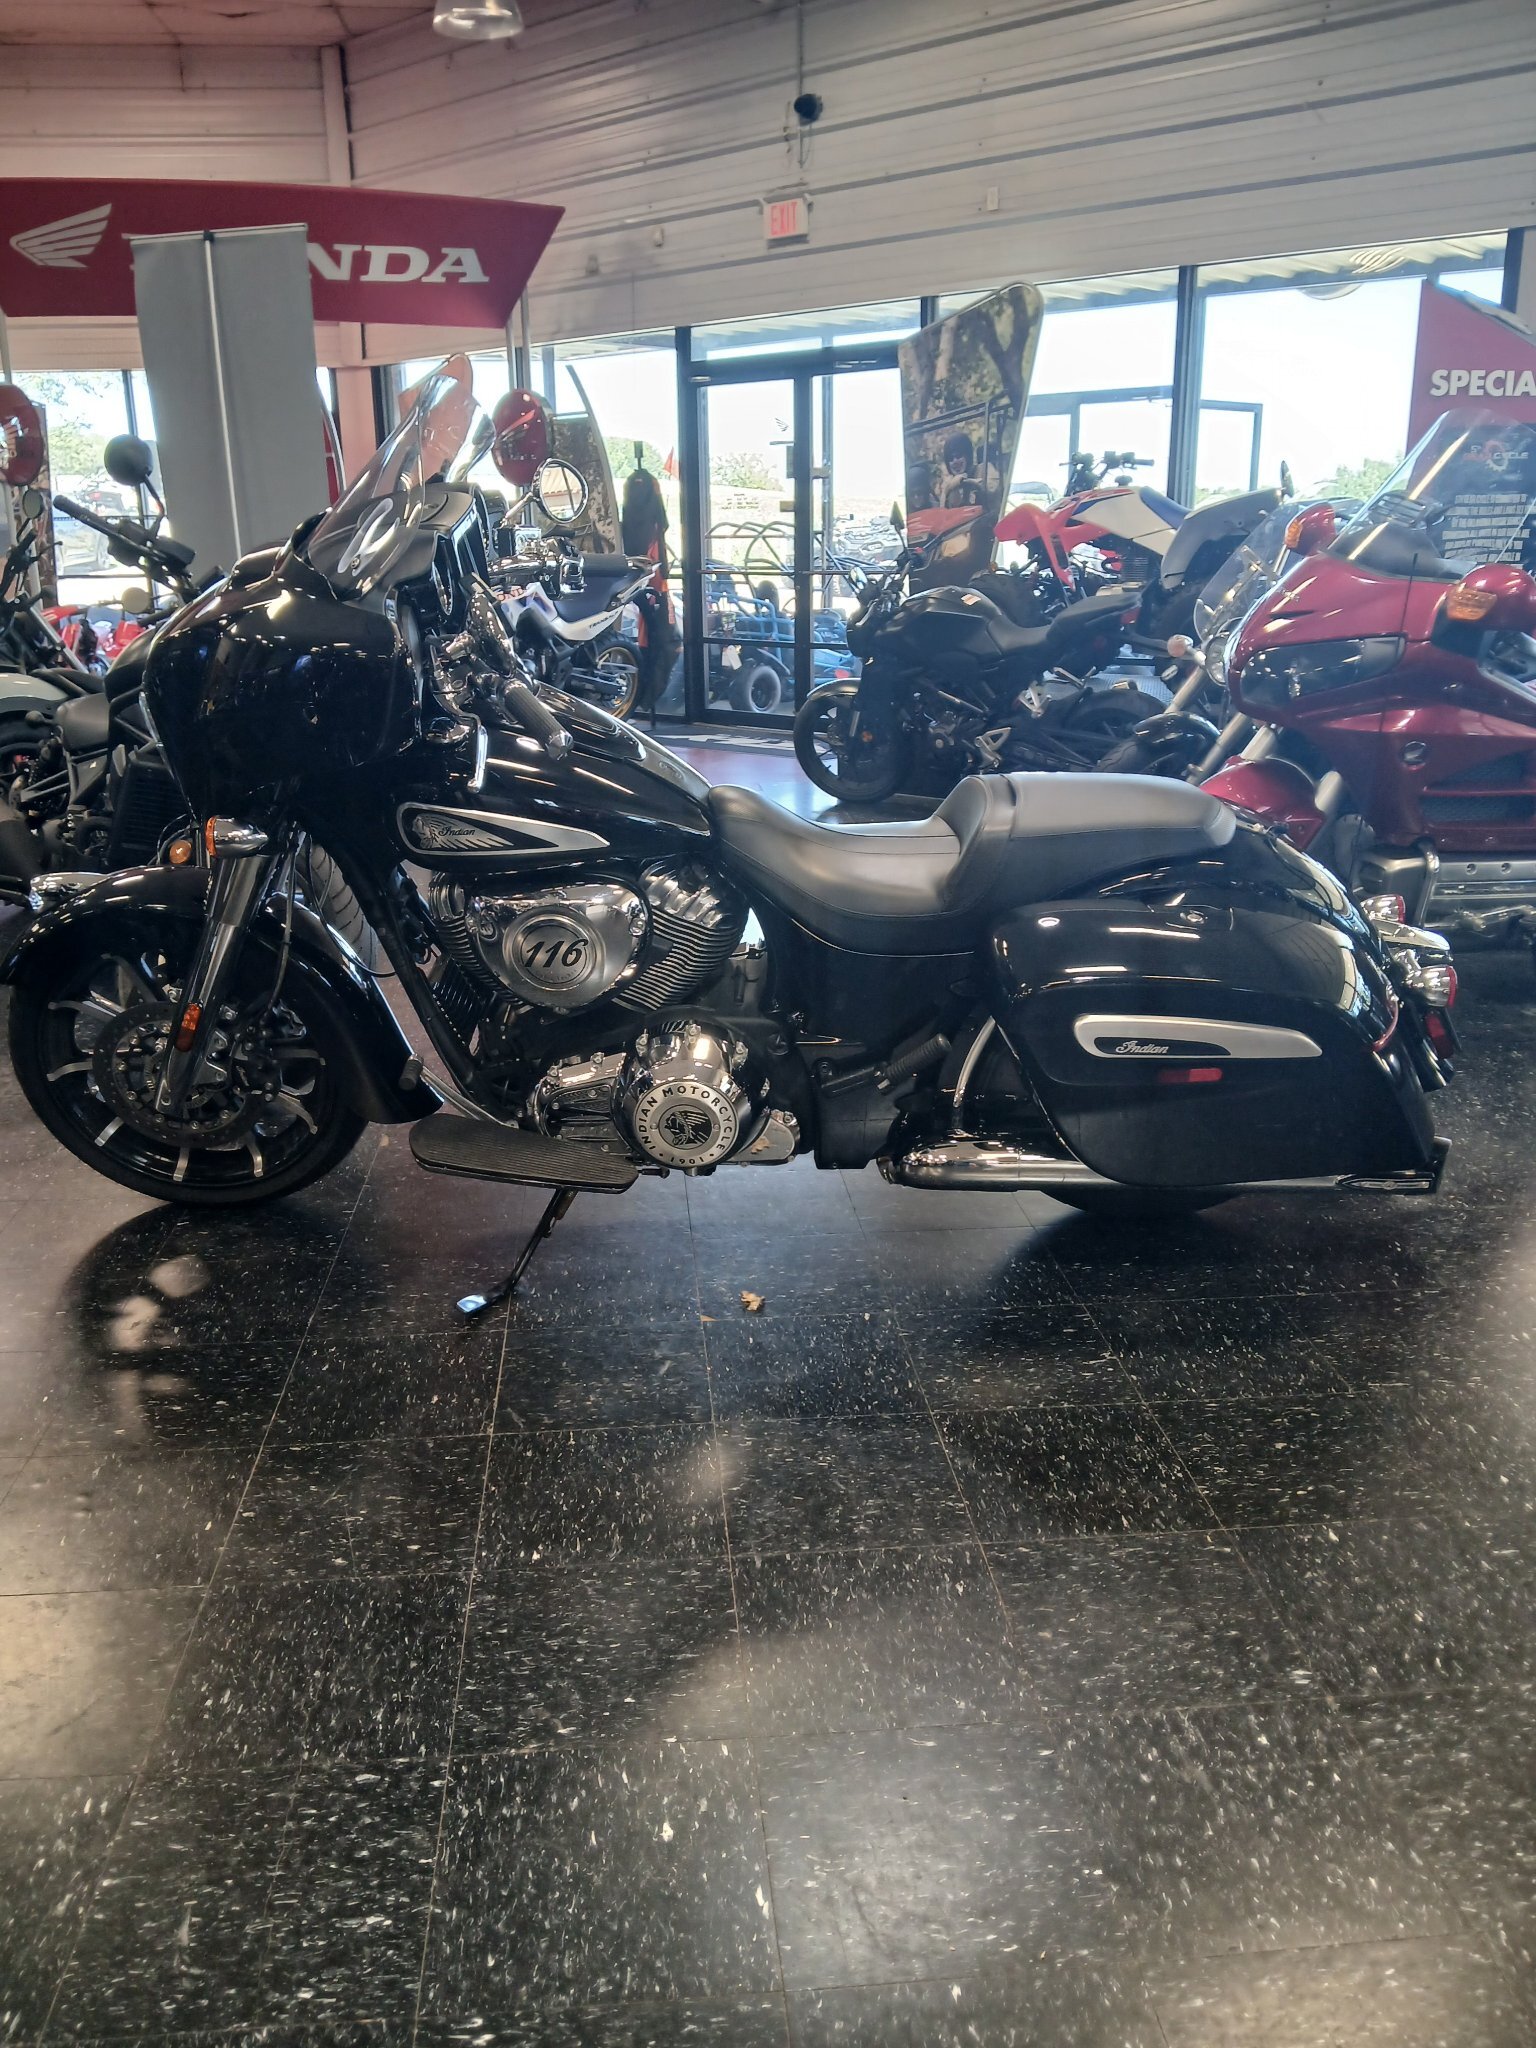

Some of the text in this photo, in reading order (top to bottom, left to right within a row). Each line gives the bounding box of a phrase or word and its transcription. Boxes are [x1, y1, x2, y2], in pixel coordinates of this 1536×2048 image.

[770, 201, 798, 236] EXIT
[306, 242, 490, 283] NDA
[1429, 369, 1536, 397] SPECIA
[438, 826, 476, 836] Indian
[524, 938, 589, 967] 116
[1115, 1040, 1169, 1054] Indian
[638, 1085, 733, 1151] INDIAN MOTORCYCLE
[670, 1156, 705, 1165] 1901
